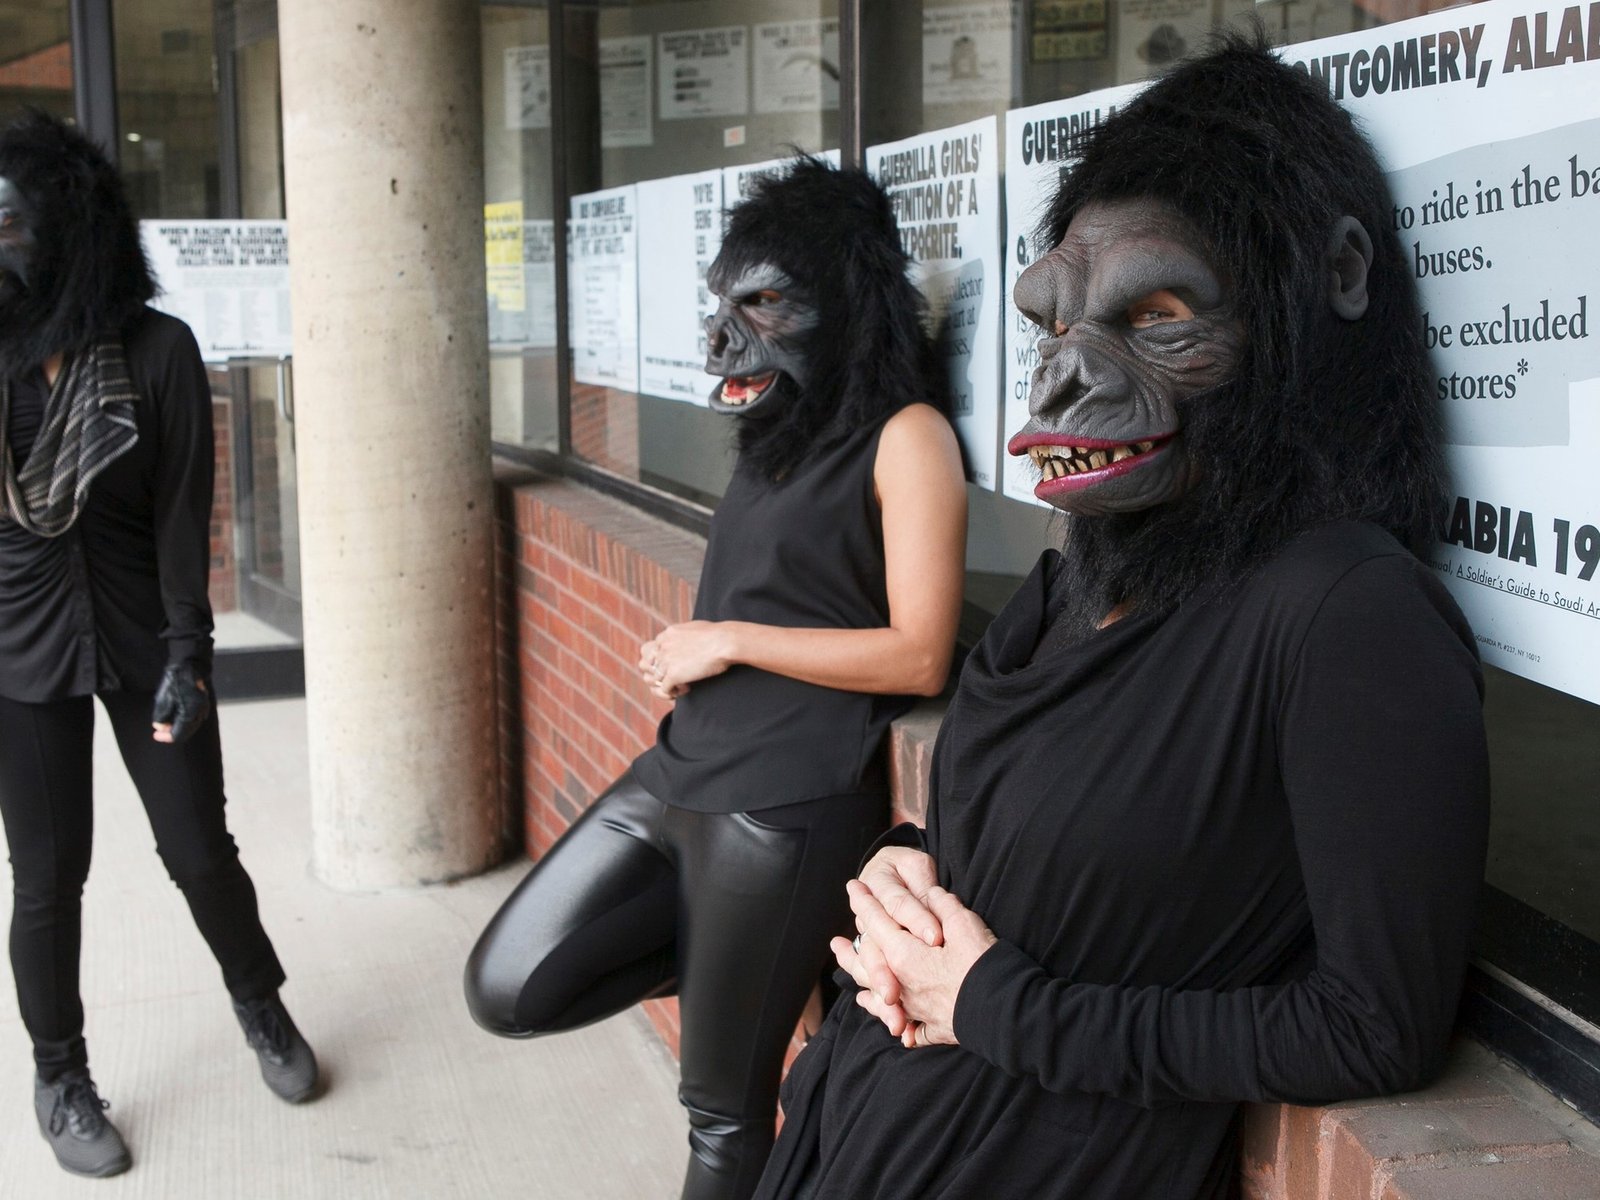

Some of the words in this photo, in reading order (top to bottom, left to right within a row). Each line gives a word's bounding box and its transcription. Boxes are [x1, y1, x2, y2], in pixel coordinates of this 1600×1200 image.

[879, 145, 936, 187] GUERRILLA
[941, 133, 982, 178] GIRLS'
[891, 183, 942, 222] FINITION
[946, 180, 963, 218] OF
[968, 178, 978, 215] A
[1394, 203, 1415, 230] to
[1421, 182, 1469, 226] ride
[1475, 180, 1504, 215] in
[1510, 164, 1561, 208] the
[1413, 241, 1492, 278] buses.
[946, 277, 982, 300] ollector
[1422, 312, 1452, 349] be
[1460, 295, 1588, 347] excluded
[1553, 518, 1600, 582] 19
[1426, 558, 1454, 577] anual,
[1467, 566, 1504, 589] Soldier's
[1506, 578, 1536, 600] Guide
[1540, 588, 1550, 603] to
[1554, 591, 1584, 612] Saudi
